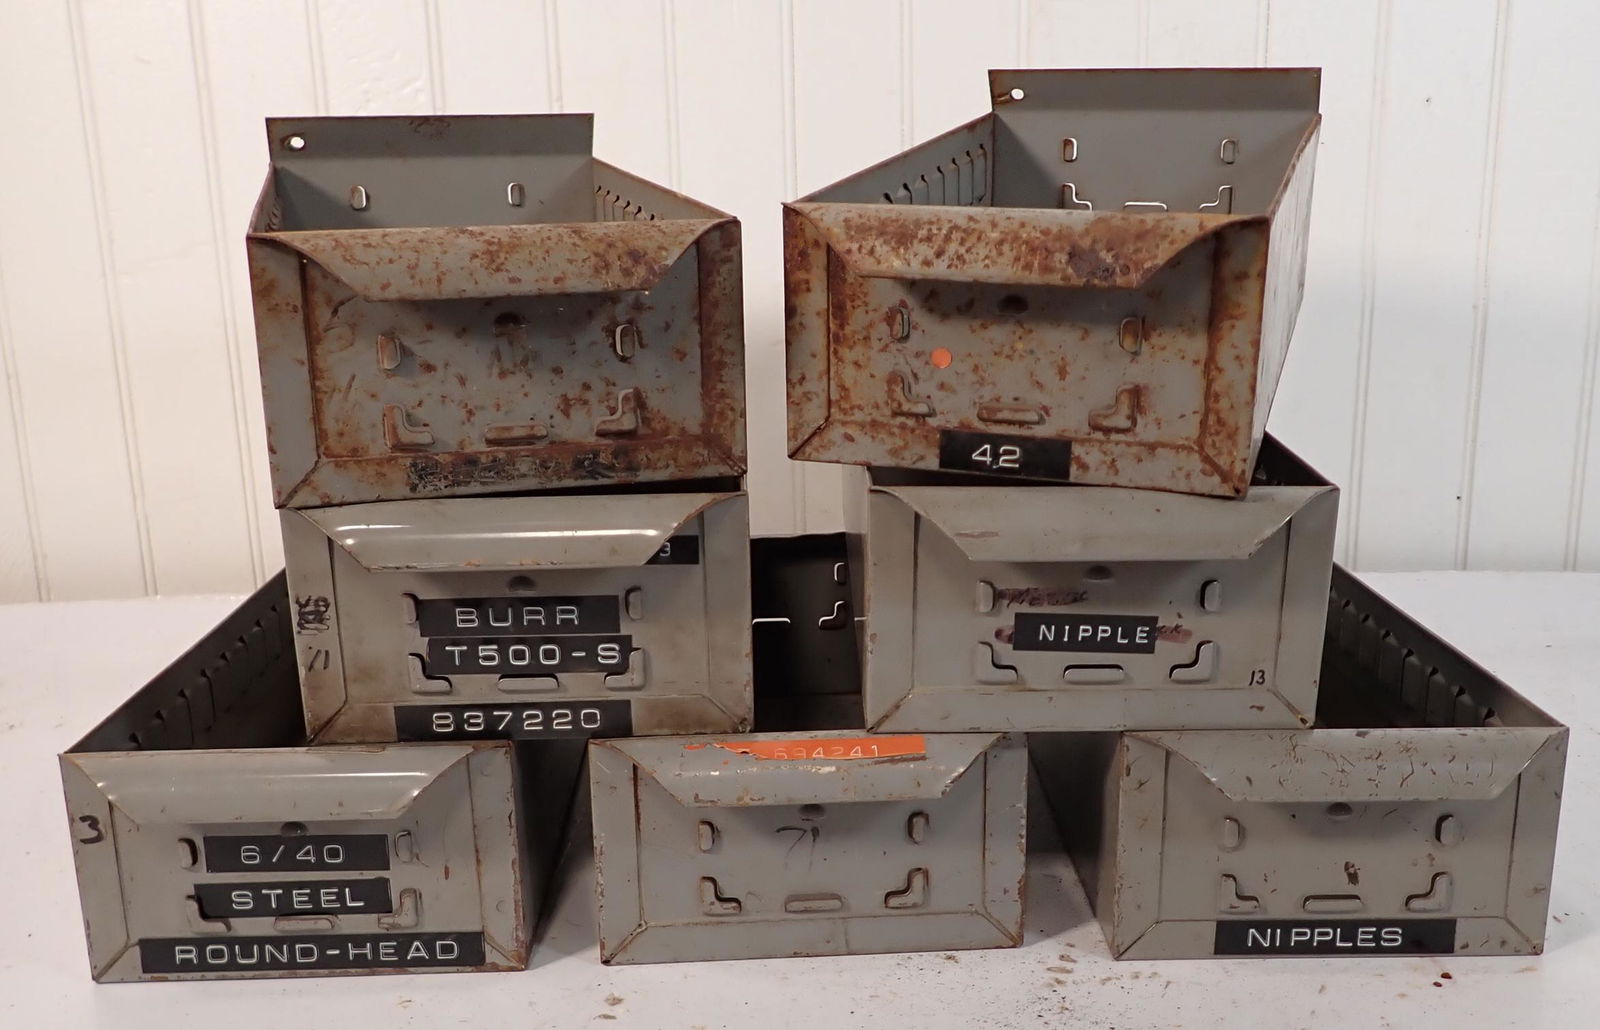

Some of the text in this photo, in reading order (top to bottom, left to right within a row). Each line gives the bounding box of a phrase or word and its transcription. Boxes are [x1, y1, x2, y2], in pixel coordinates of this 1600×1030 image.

[971, 444, 1020, 469] 42
[455, 606, 579, 628] BURR
[1038, 624, 1151, 644] NIPPLE
[445, 644, 622, 666] T500-S
[1248, 669, 1266, 687] 13
[433, 709, 601, 732] 837220
[79, 814, 104, 845] 3
[240, 845, 346, 864] 6/40
[231, 888, 365, 910] STEEL
[1247, 927, 1403, 947] NIPPLES
[175, 940, 460, 965] ROUND-HEAD
